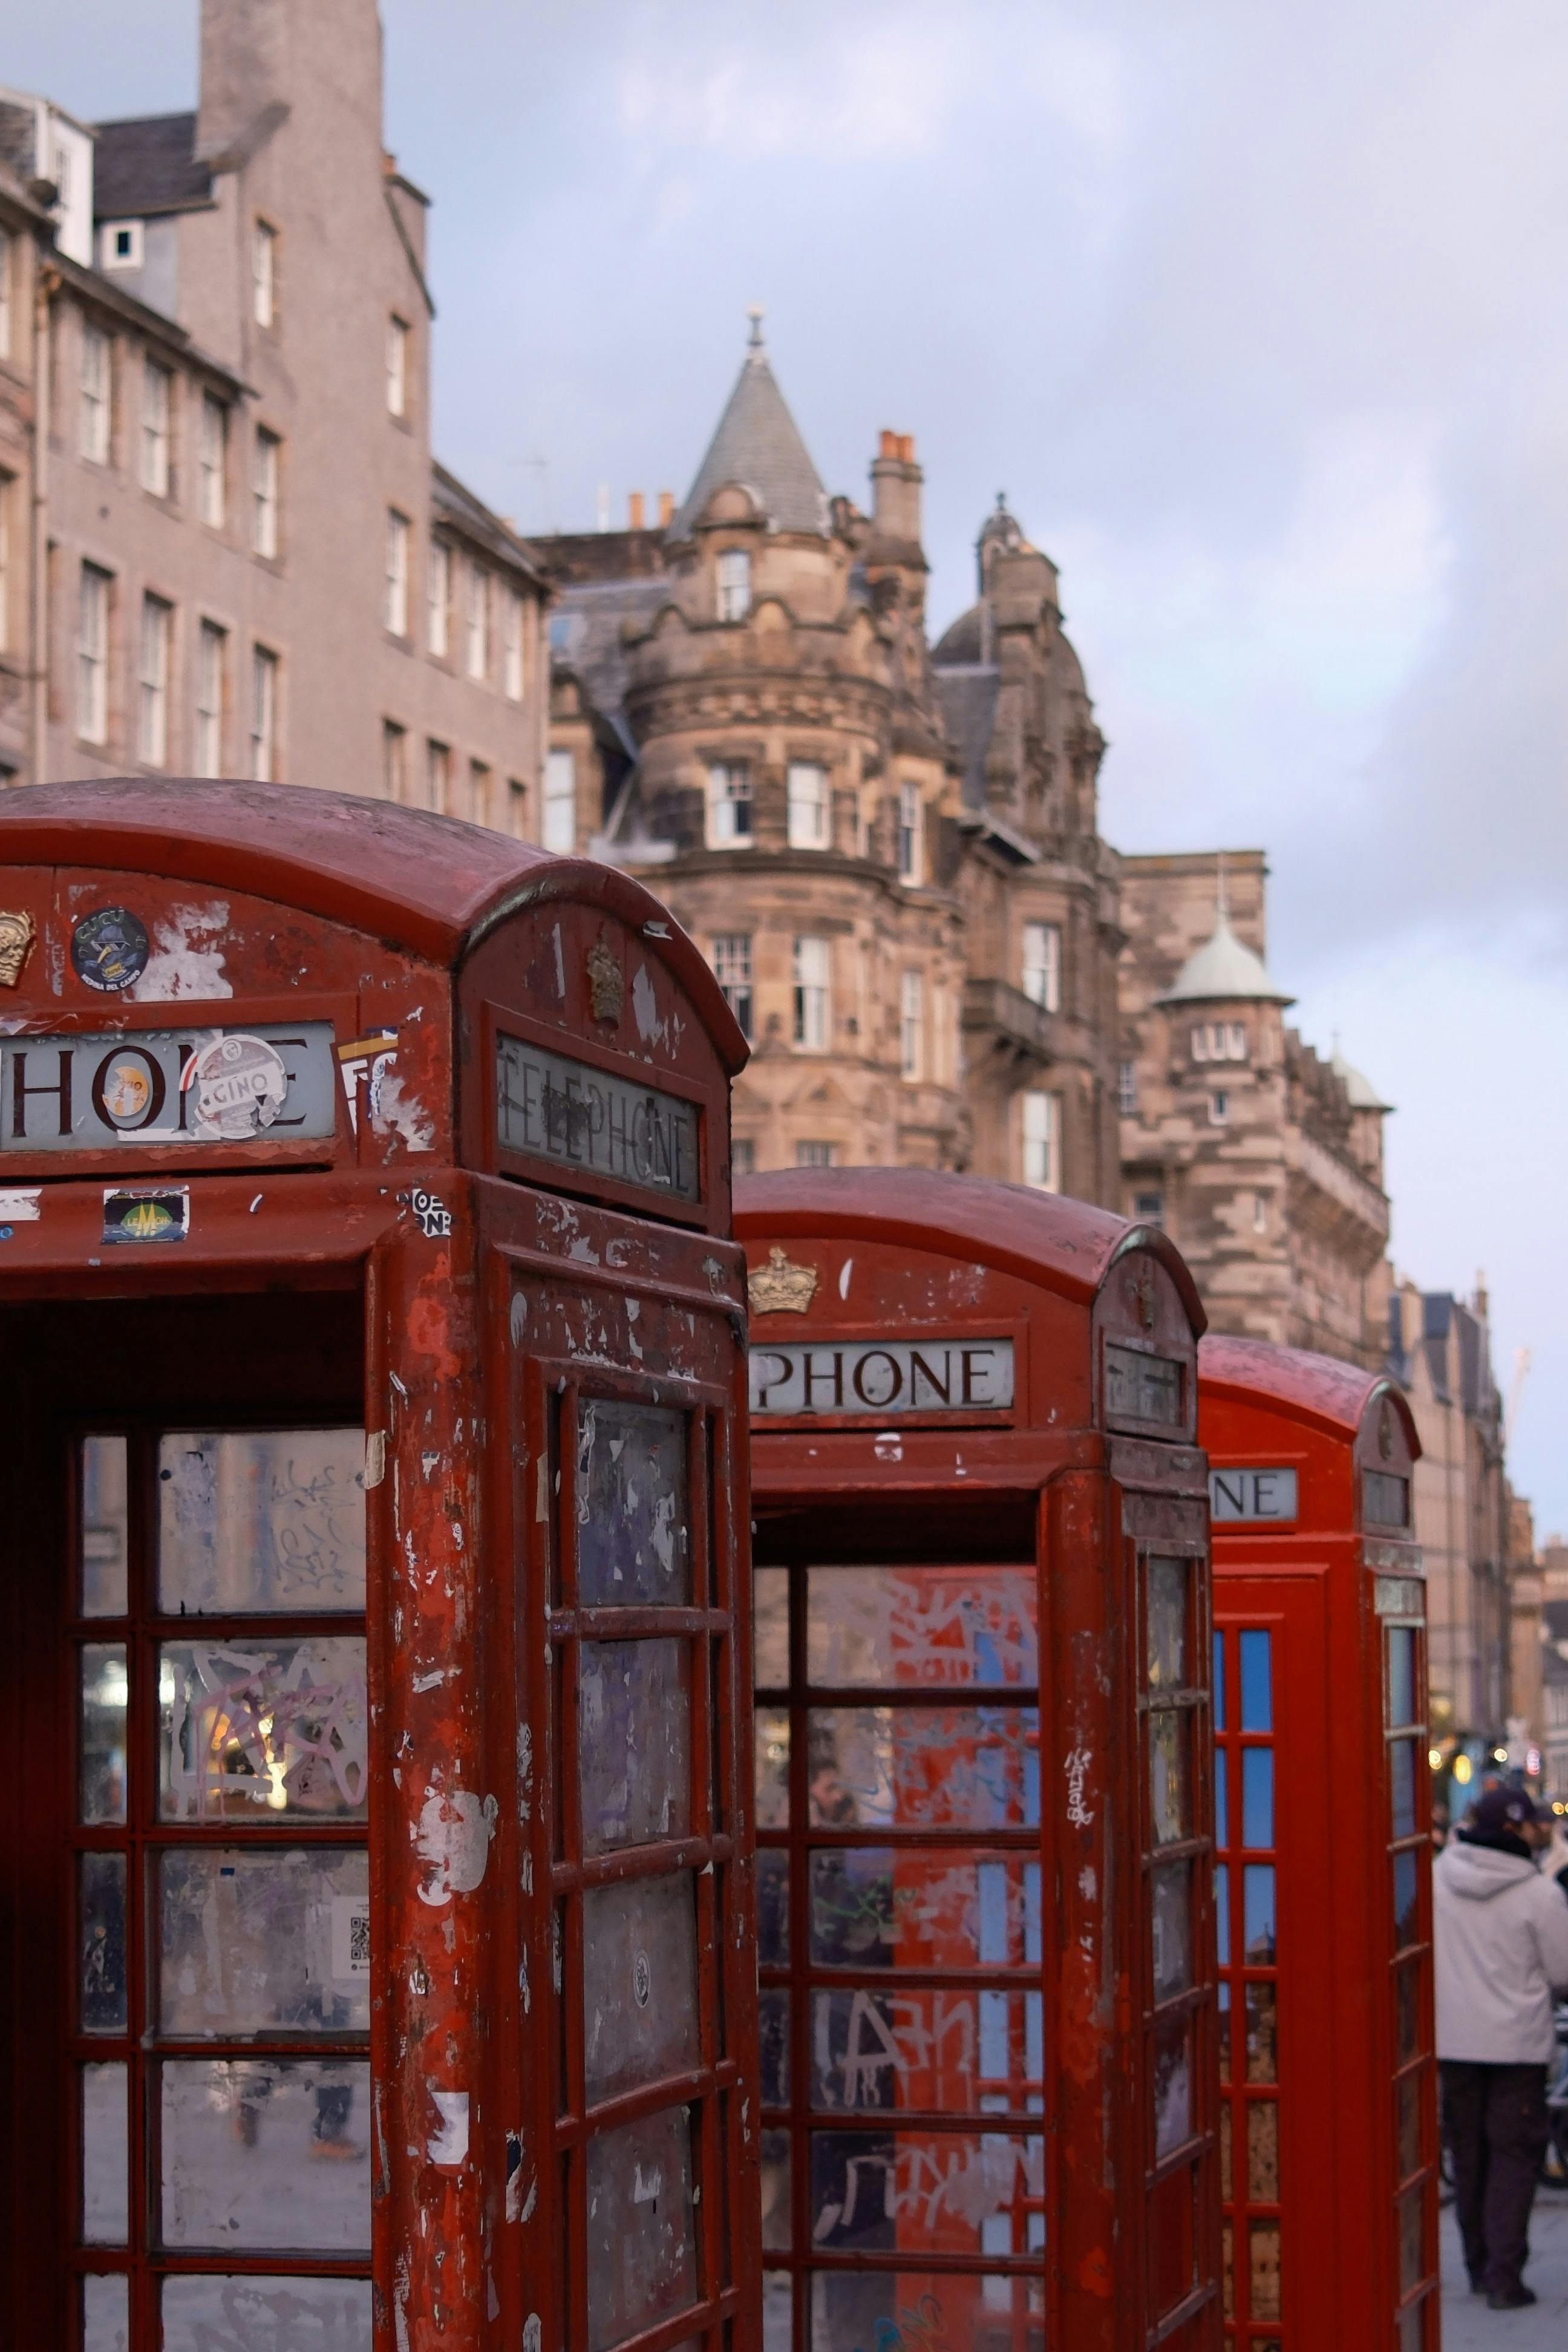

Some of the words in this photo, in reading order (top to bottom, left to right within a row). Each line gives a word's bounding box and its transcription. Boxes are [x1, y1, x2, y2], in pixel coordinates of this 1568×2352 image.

[106, 983, 120, 991] DEL
[497, 1050, 690, 1194] TELEPHONE
[126, 1200, 169, 1238] LEMON
[756, 1349, 995, 1408] PHONE
[1214, 1474, 1279, 1515] NE
